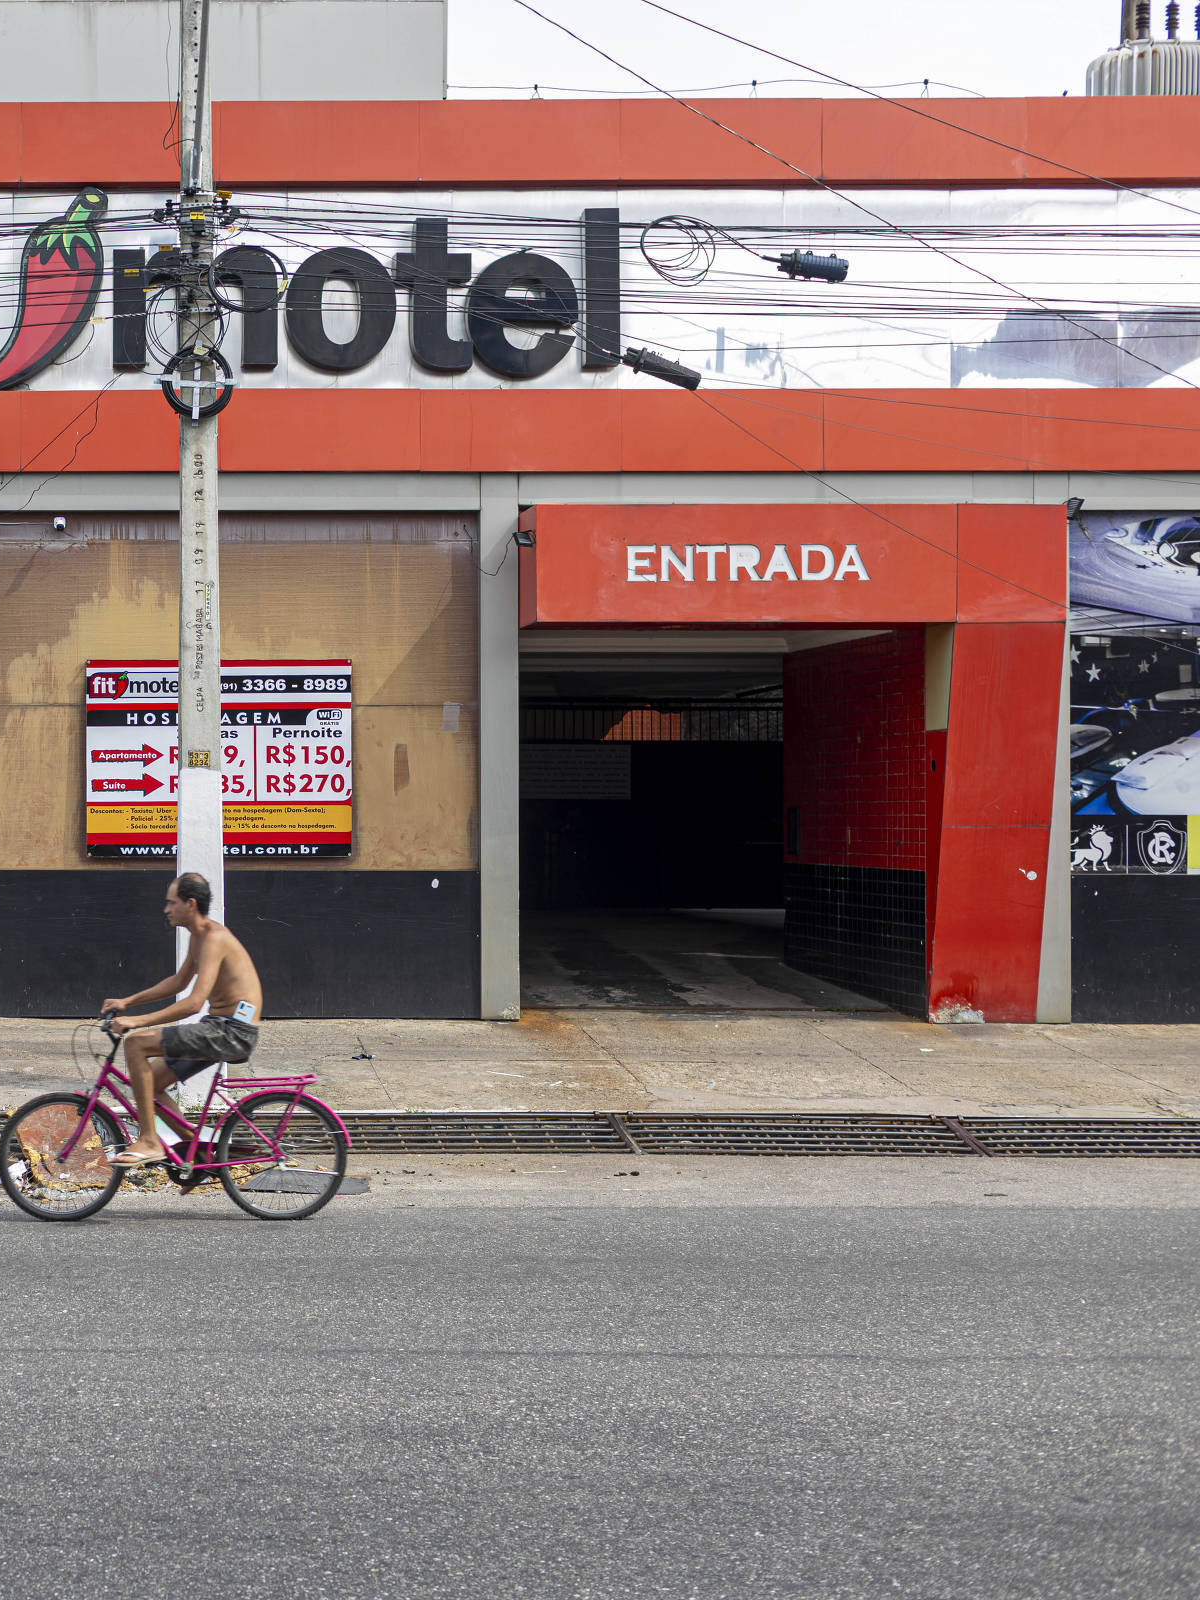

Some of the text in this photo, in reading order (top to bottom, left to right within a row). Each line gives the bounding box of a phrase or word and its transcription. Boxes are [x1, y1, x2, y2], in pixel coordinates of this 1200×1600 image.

[113, 207, 620, 379] motel
[625, 542, 872, 583] ENTRADA
[92, 676, 179, 695] fit mote
[220, 682, 239, 692] (91)
[242, 678, 287, 692] 3366
[302, 678, 348, 692] 8989
[126, 712, 282, 726] HOSAGEM
[272, 727, 343, 739] Pernoite
[98, 752, 158, 761] Apartamento
[243, 807, 283, 815] hospedagem
